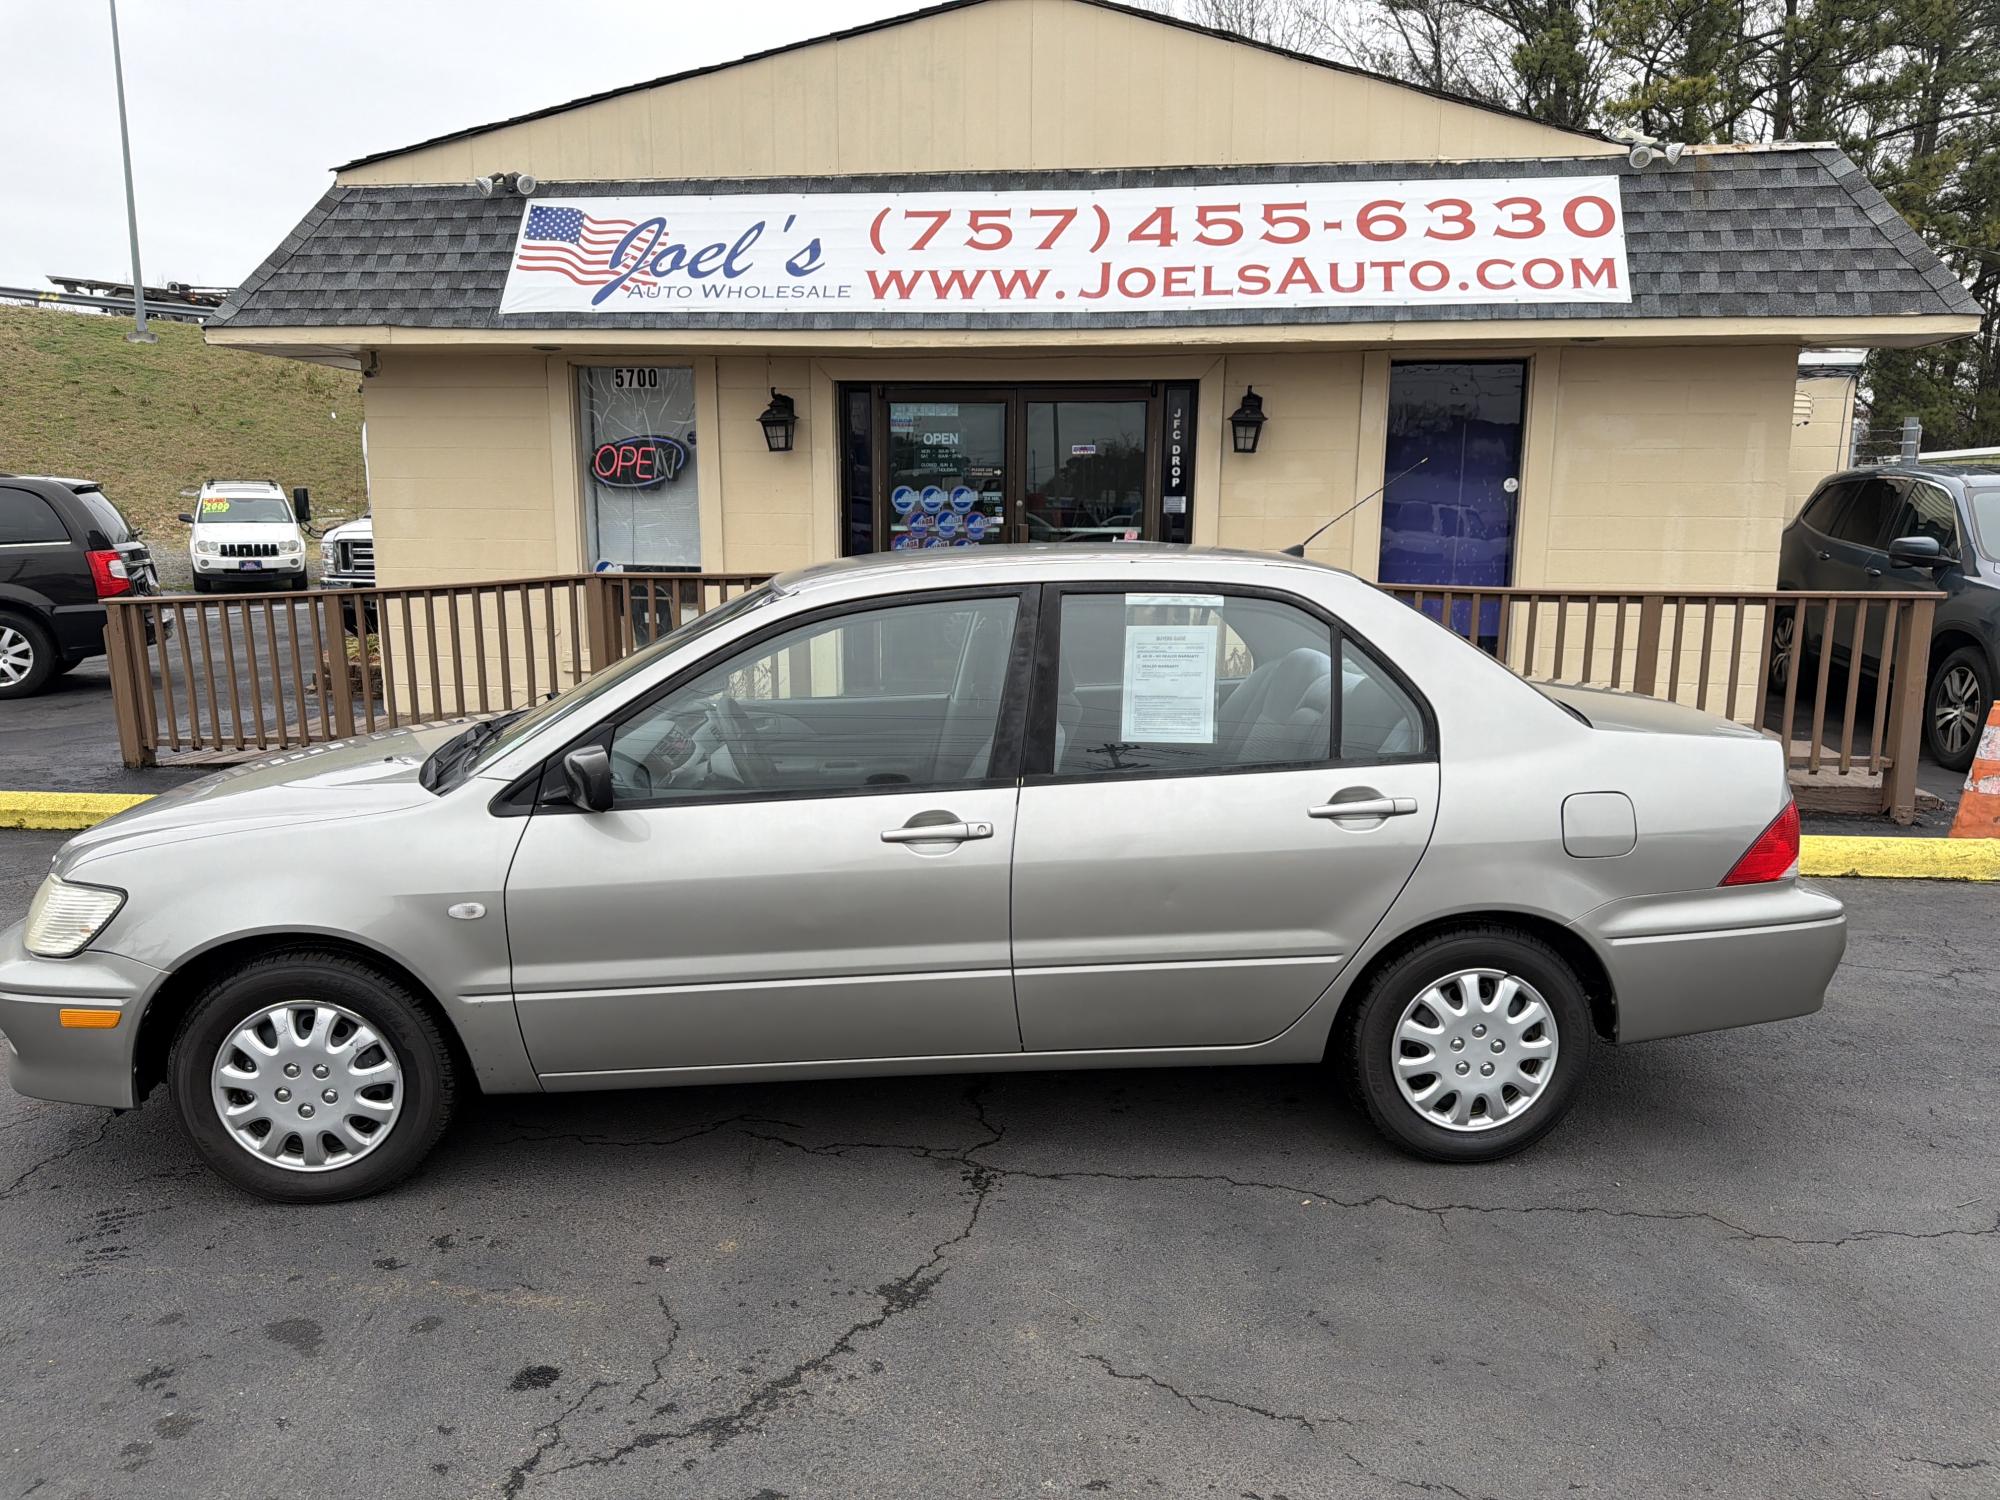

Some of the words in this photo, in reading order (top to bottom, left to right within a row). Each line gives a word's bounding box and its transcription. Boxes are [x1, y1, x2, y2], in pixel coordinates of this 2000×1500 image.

[591, 213, 825, 305] Joel's
[615, 368, 658, 388] 5700
[923, 432, 959, 445] OPEN
[594, 444, 676, 480] OPEN
[1171, 444, 1181, 487] DROP
